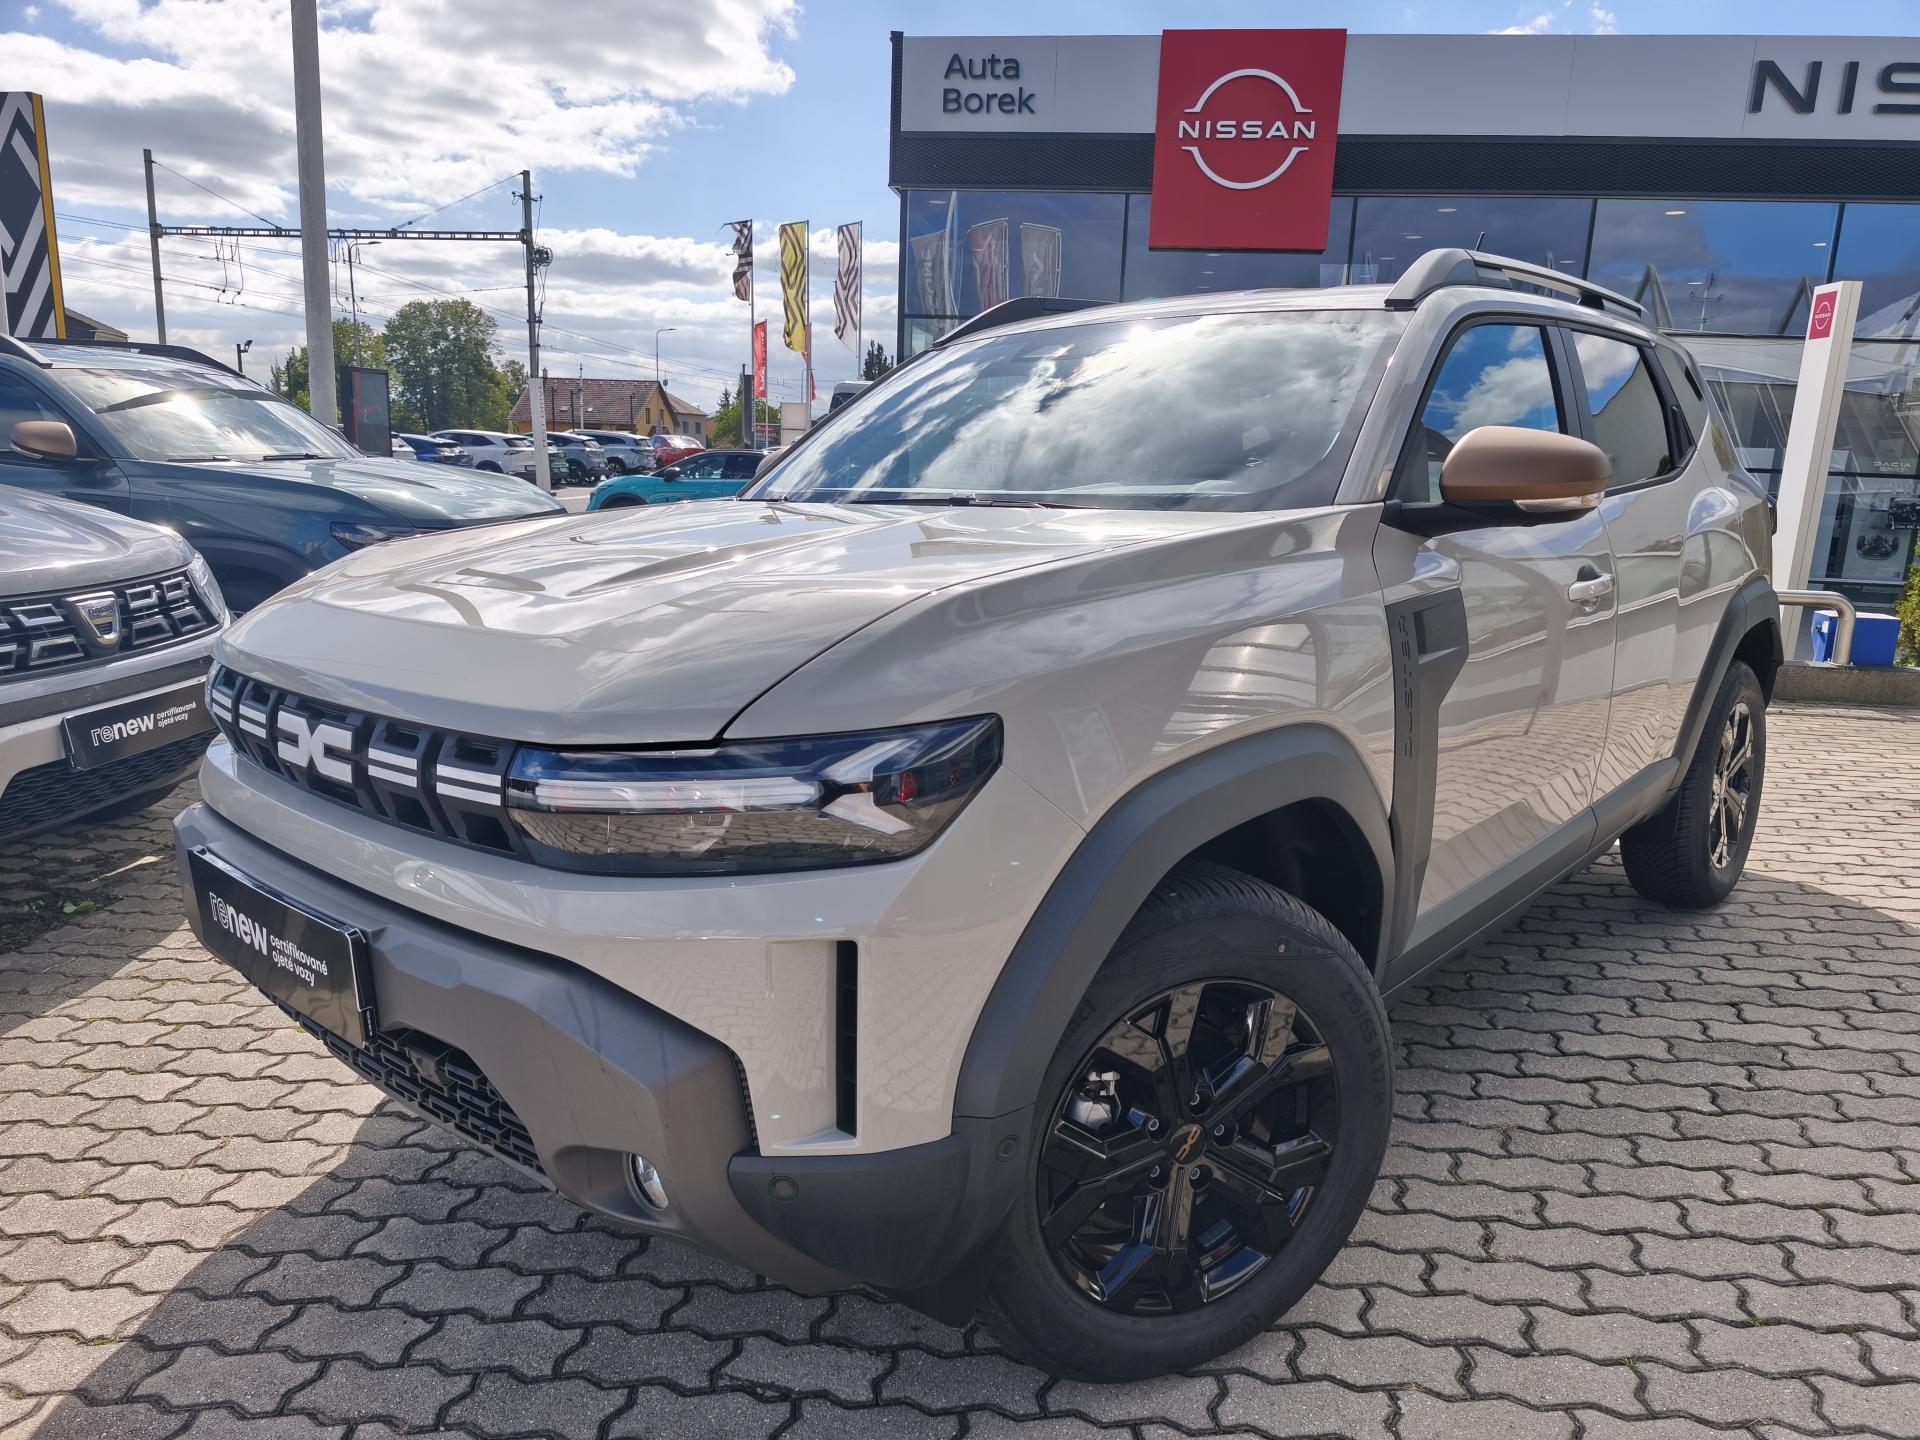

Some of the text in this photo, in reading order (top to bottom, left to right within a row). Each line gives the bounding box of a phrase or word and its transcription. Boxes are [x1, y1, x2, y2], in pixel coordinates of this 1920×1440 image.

[944, 53, 1020, 79] Auta
[943, 87, 1036, 113] Borek
[1178, 120, 1316, 139] NISSAN
[1815, 312, 1832, 320] NISSAN
[1399, 615, 1413, 759] DUSTER
[157, 701, 197, 719] certifikované
[157, 712, 189, 728] ojeté vozy
[91, 713, 155, 746] renew
[209, 891, 267, 956] renew
[270, 934, 328, 976] certifikované
[272, 950, 315, 987] ojeté vozy
